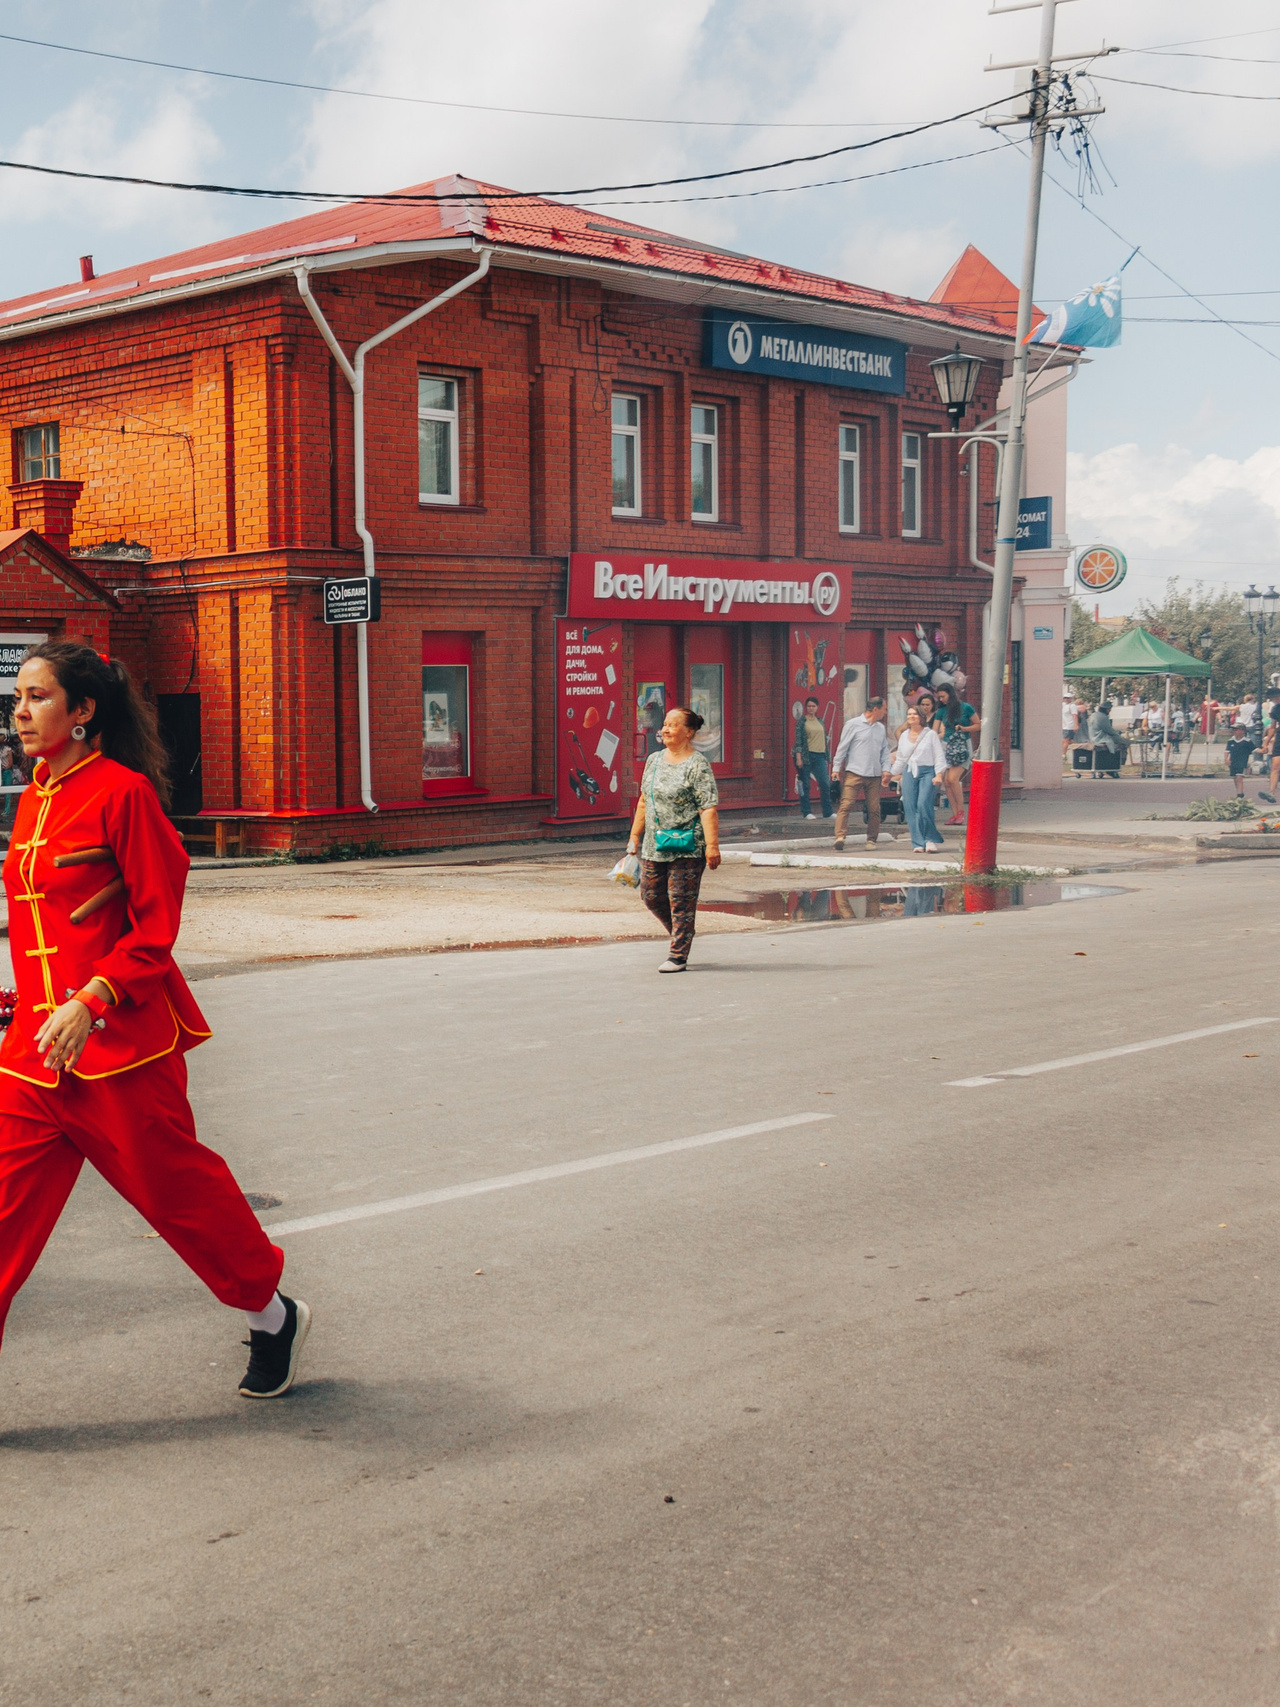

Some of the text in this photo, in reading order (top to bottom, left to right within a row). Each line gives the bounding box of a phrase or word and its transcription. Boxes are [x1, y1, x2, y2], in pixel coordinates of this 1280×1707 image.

[760, 335, 892, 378] МЕТАЛЛИНВЕСТБАНК
[1016, 511, 1047, 523] КОМАТ
[565, 629, 578, 640] ВСЁ
[565, 645, 604, 656] ДЛЯ ДОМА,
[565, 659, 587, 670] ДАЧИ,
[566, 670, 597, 682] СТРОЙКИ
[566, 686, 604, 696] И РЕМОНТА
